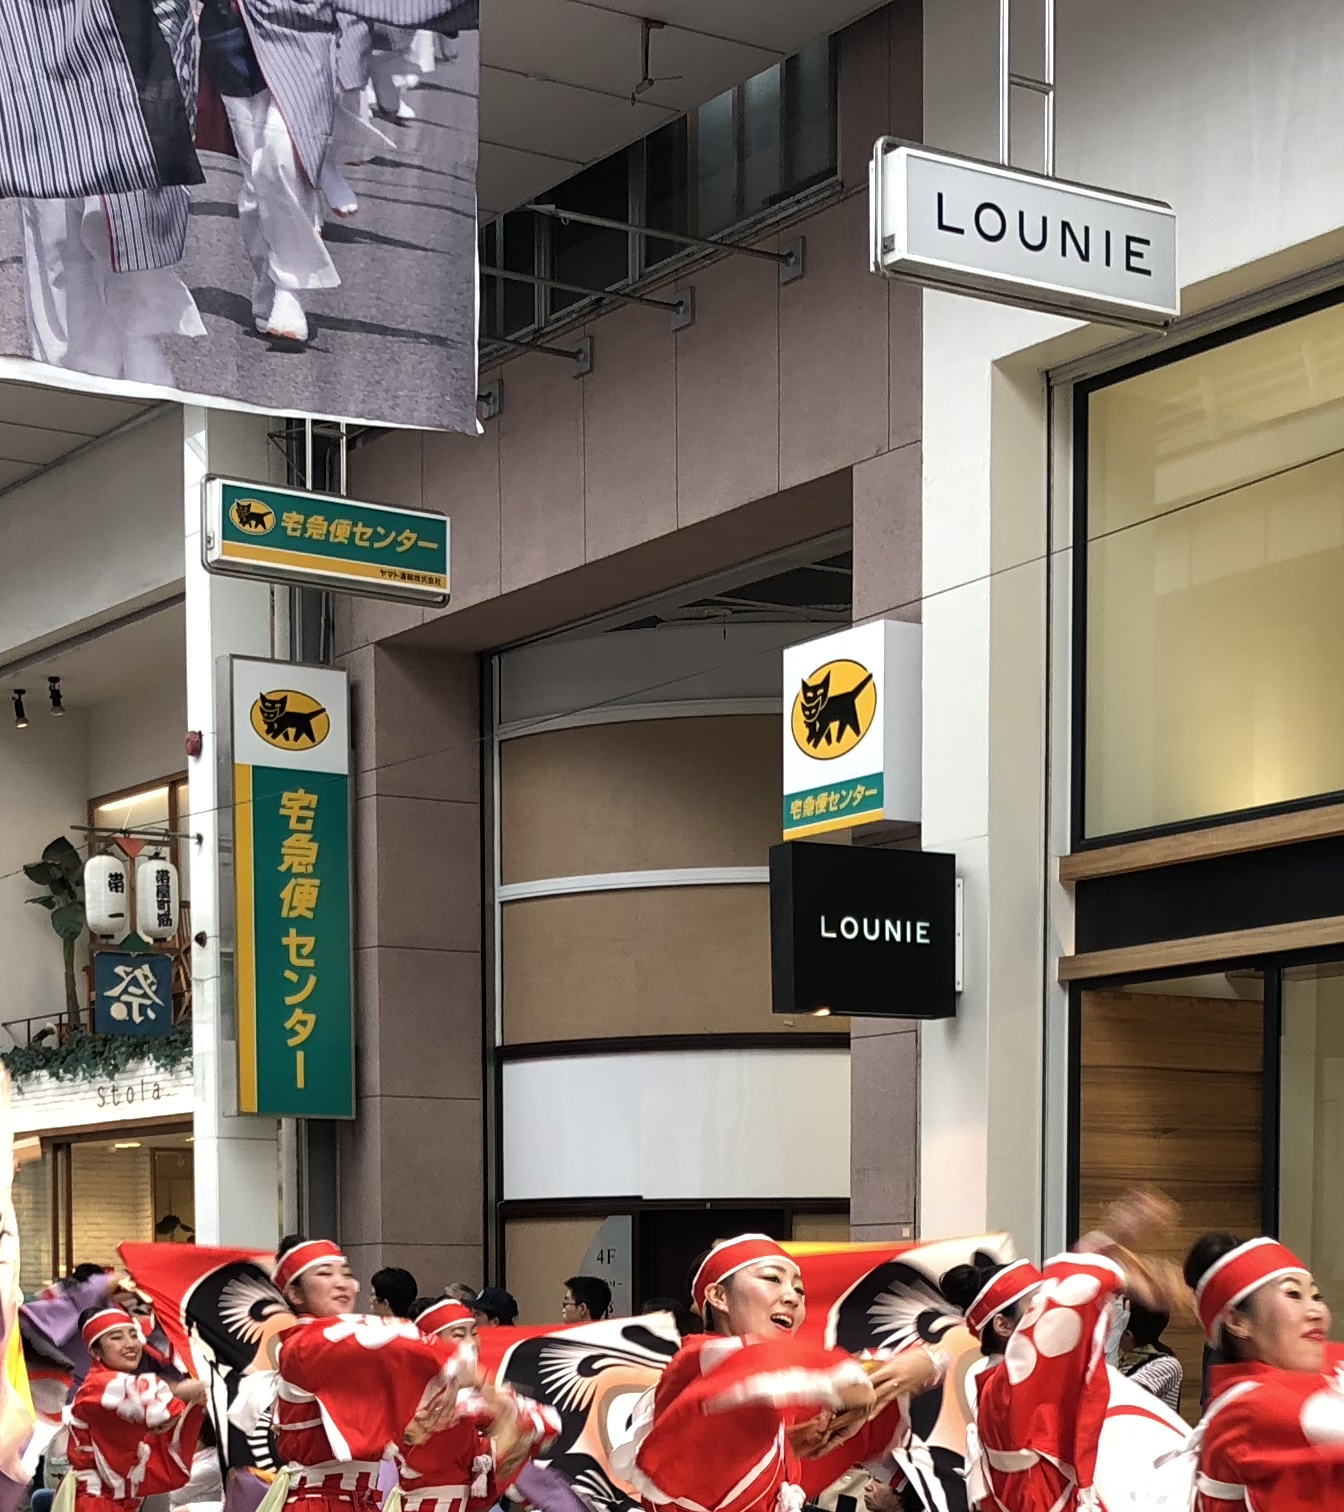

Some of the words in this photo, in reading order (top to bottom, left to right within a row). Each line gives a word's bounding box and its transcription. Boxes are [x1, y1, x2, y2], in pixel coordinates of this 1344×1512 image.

[937, 192, 1151, 277] LOUNIE
[281, 511, 438, 552] 宅急便センター
[790, 783, 878, 820] 宅急便センター
[277, 788, 320, 1089] 宅急便センター
[820, 915, 931, 944] LOUNIE
[596, 1249, 616, 1264] 4F
